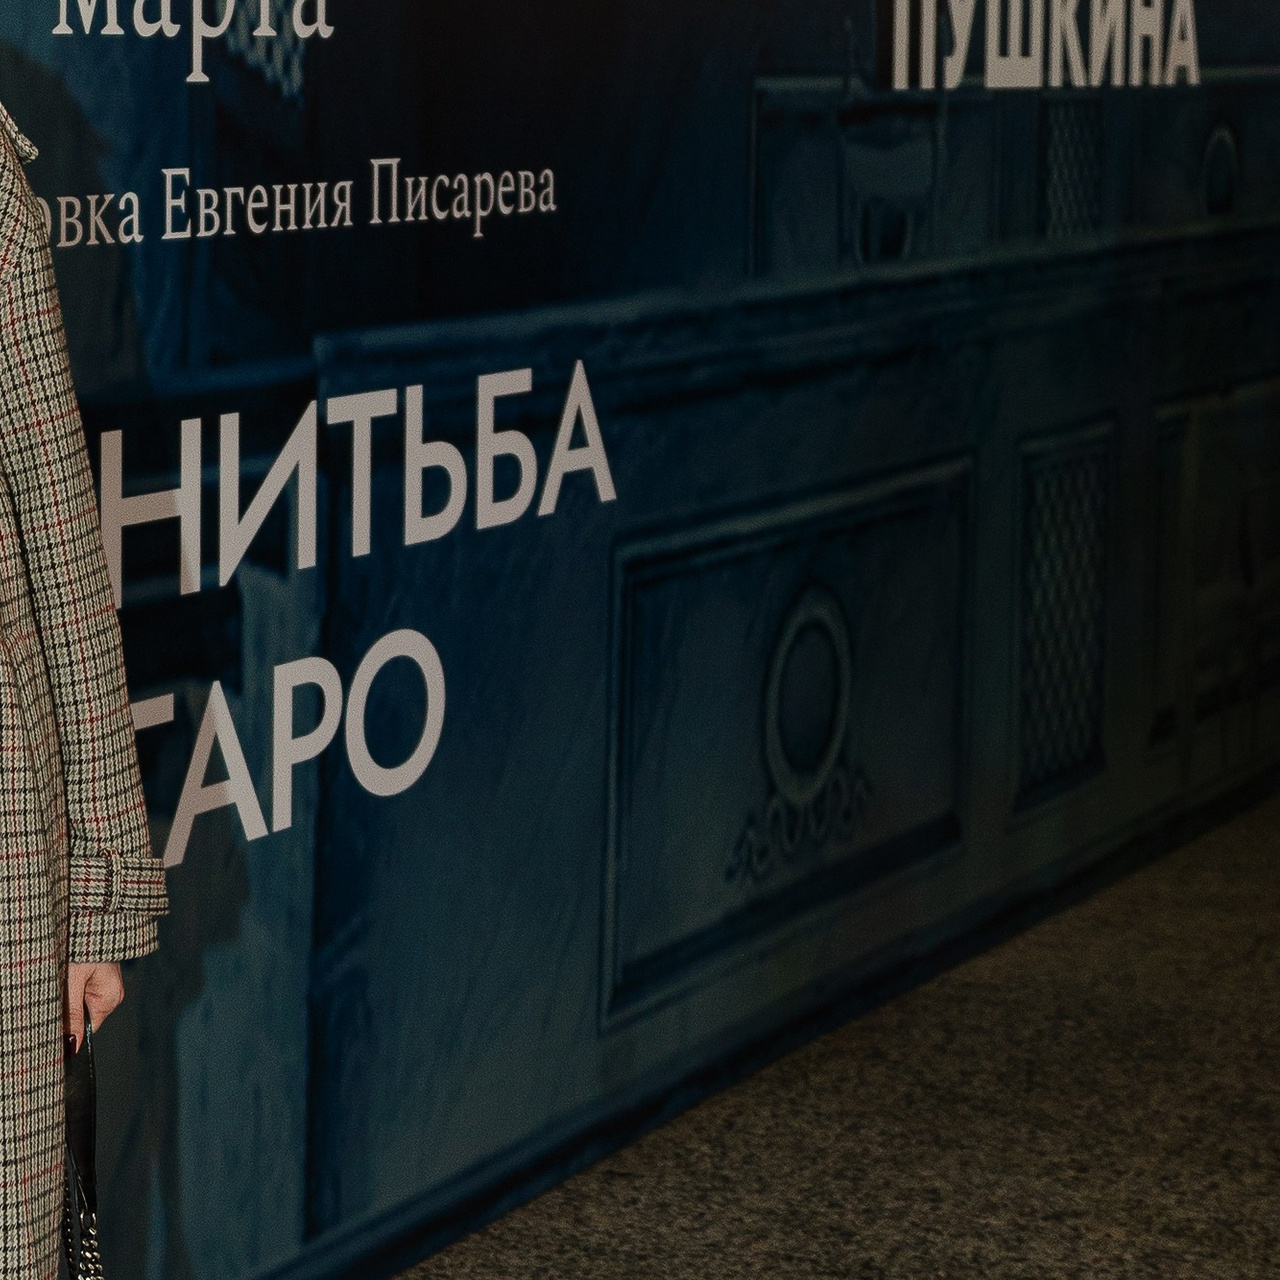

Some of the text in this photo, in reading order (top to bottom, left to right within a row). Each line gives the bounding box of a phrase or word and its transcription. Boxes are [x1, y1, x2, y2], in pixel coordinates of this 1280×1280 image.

[160, 167, 354, 241] Евгения
[368, 157, 559, 239] Писарева
[100, 359, 617, 611] НИТЬБА
